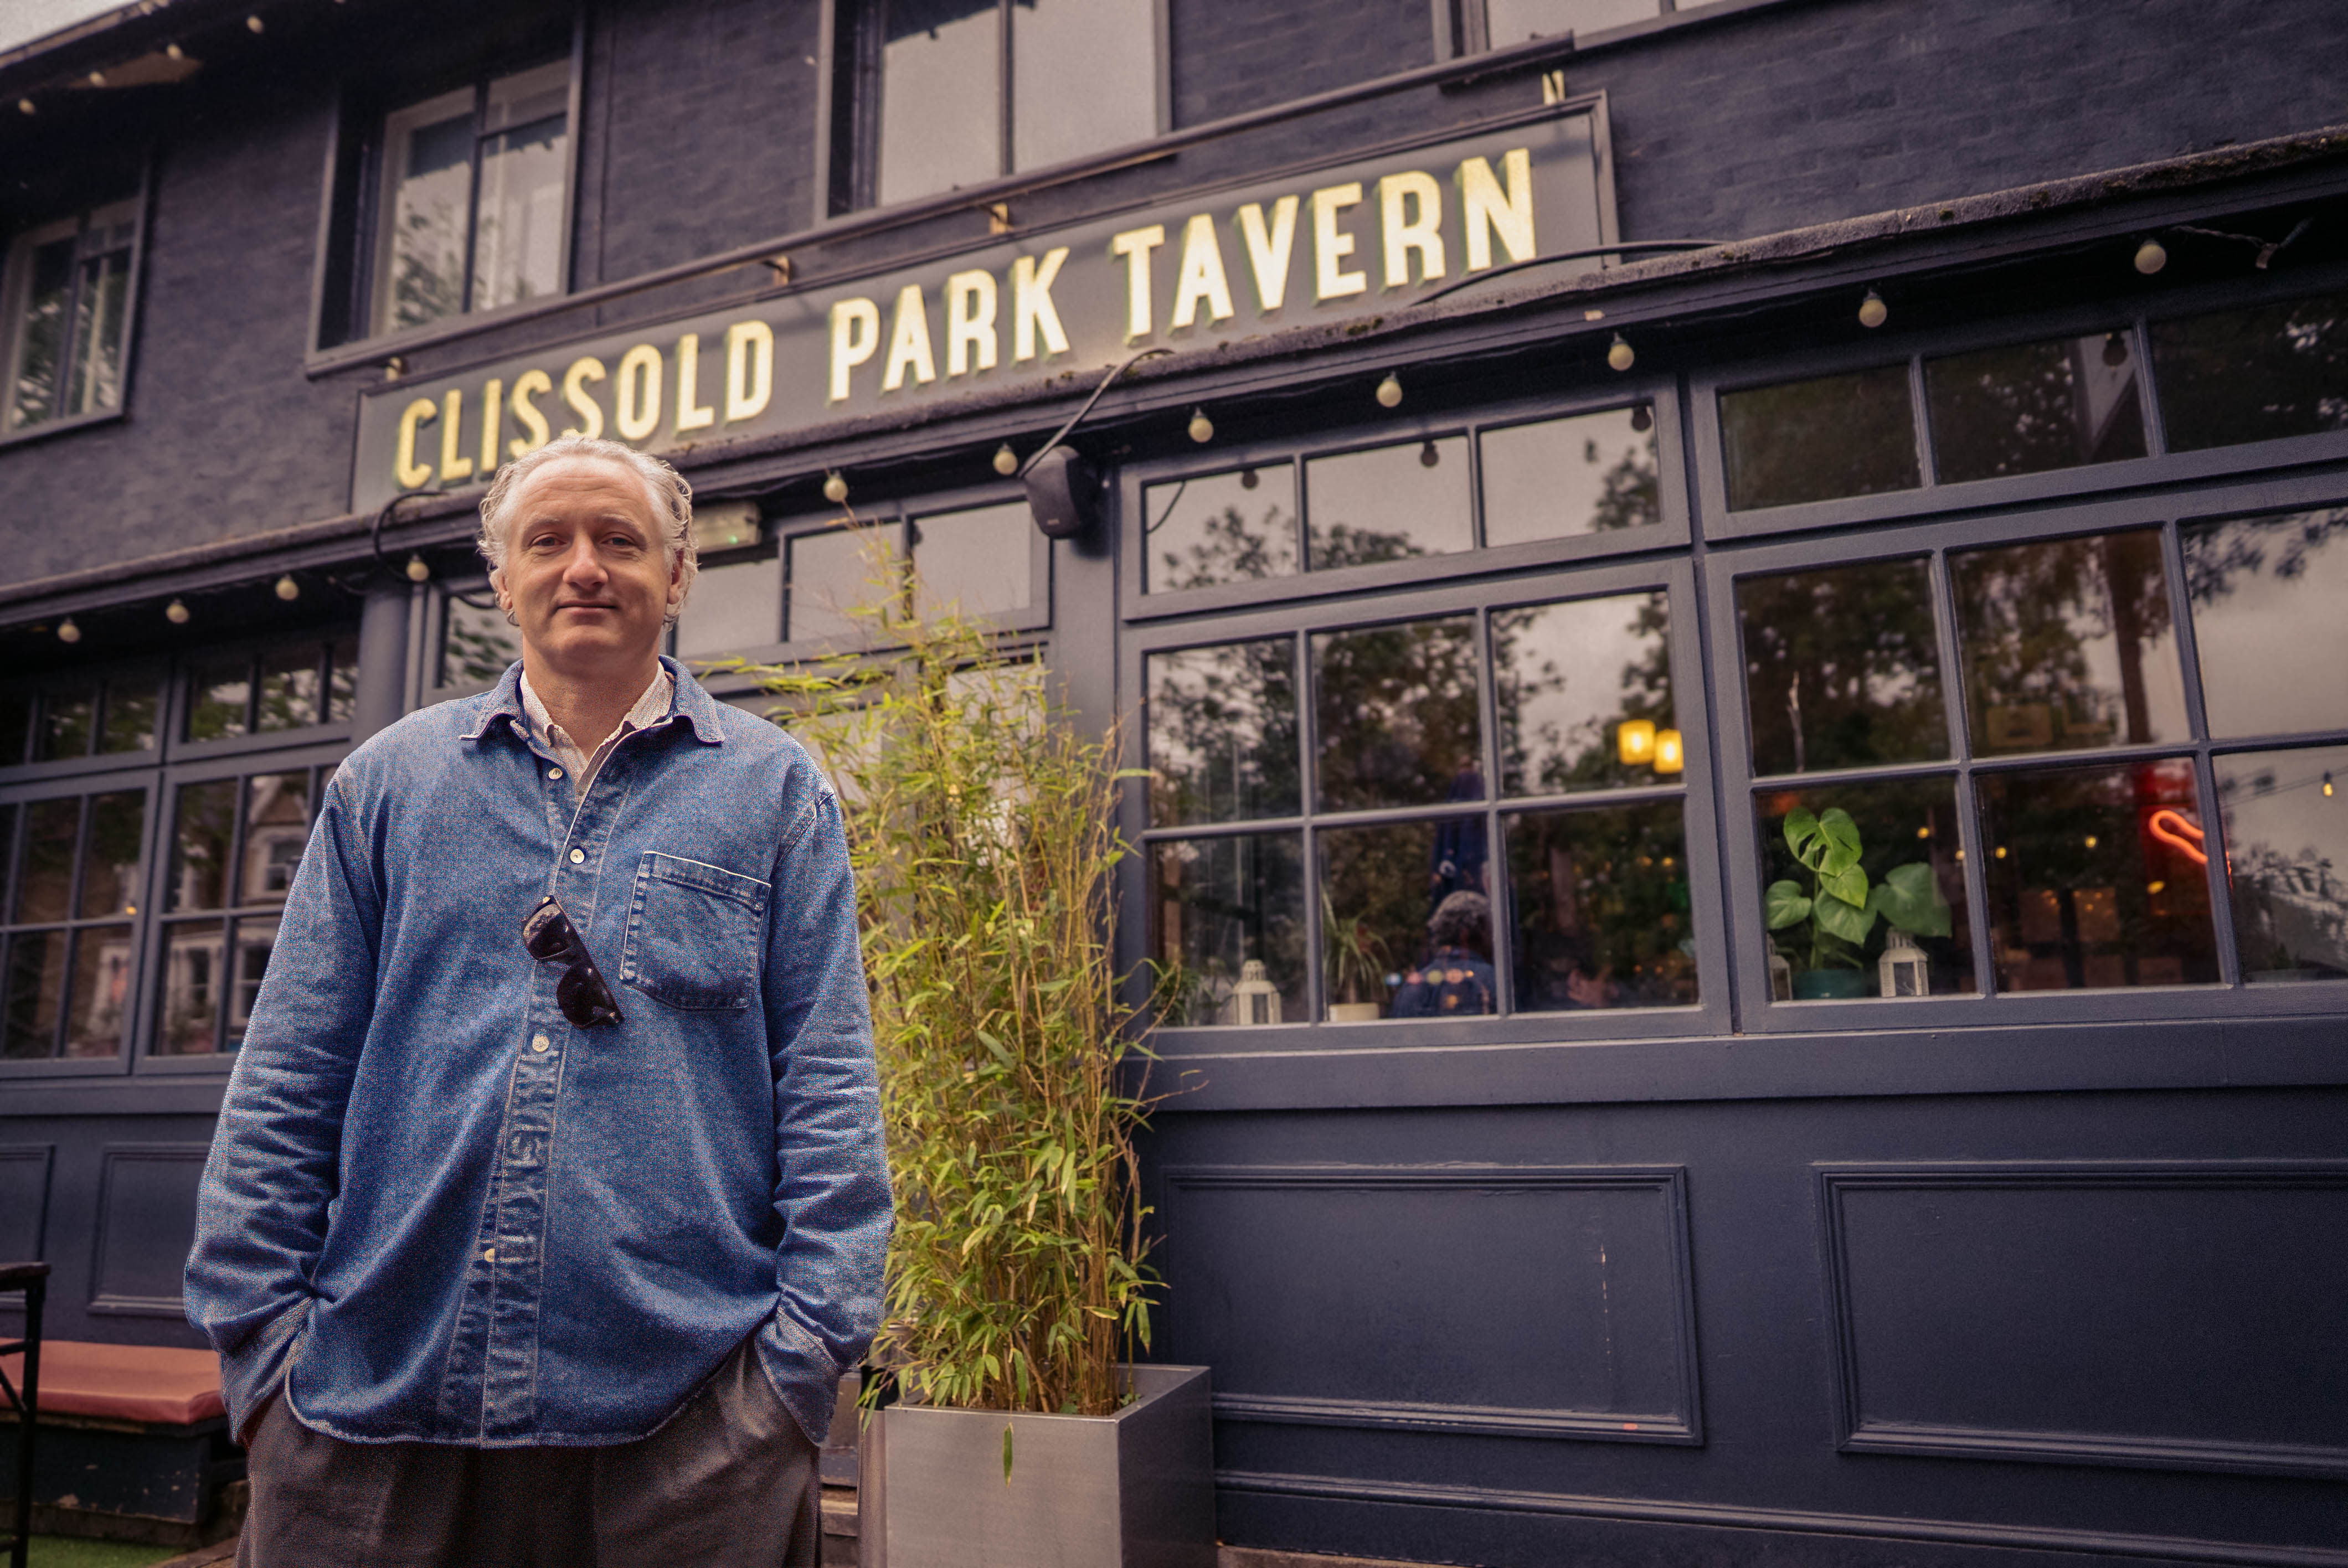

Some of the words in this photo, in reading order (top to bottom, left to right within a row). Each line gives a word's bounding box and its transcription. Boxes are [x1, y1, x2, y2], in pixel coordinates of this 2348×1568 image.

[397, 320, 774, 489] CLISSOLD
[830, 246, 1069, 403] PARK
[1113, 148, 1536, 337] TAVERN
